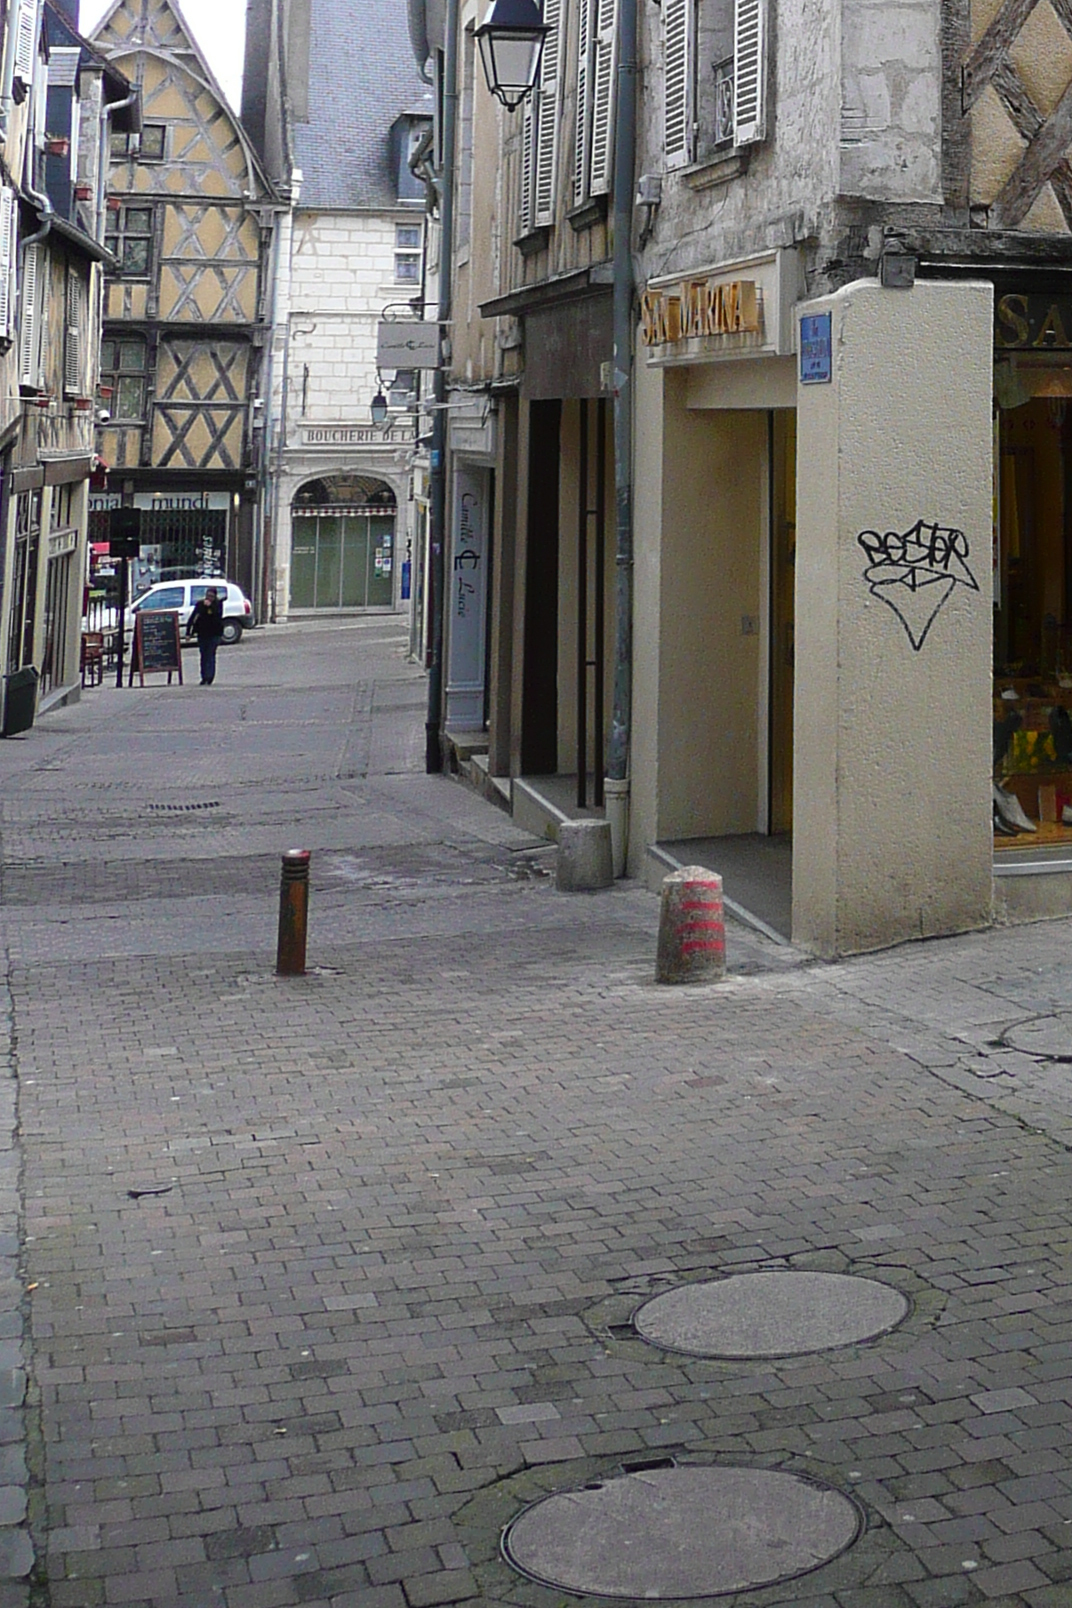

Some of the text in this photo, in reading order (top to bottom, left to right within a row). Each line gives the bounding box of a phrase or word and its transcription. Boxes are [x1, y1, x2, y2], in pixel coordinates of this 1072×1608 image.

[307, 429, 377, 442] BOUCHERIE
[382, 429, 398, 442] DE
[151, 493, 209, 510] mundi
[460, 492, 478, 544] Camille
